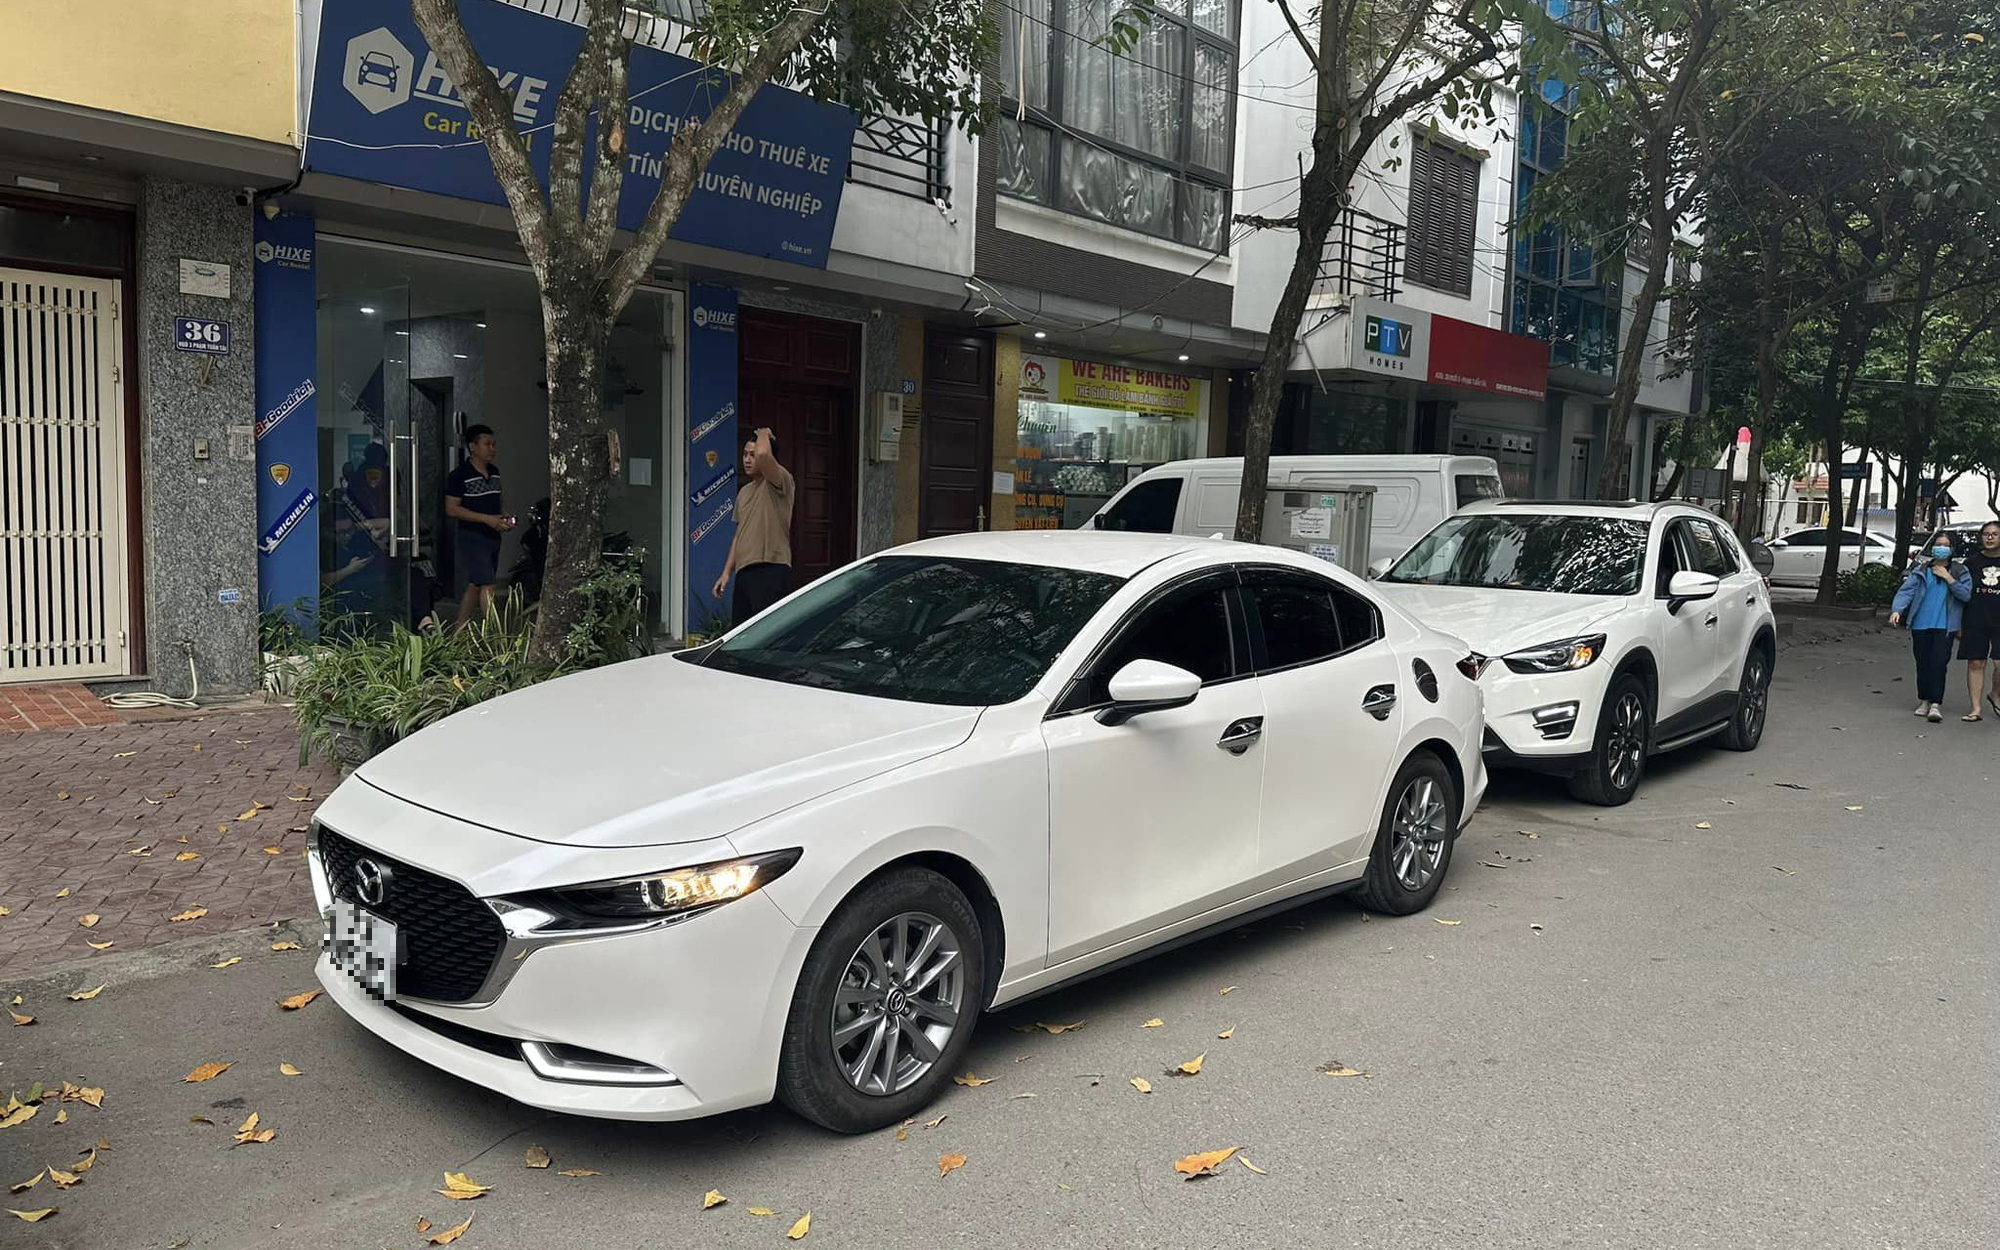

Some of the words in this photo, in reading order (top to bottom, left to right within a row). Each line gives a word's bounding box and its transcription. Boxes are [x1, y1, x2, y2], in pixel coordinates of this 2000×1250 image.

[416, 51, 548, 118] HE
[424, 112, 461, 135] Car
[629, 106, 679, 135] DỊCH
[720, 131, 754, 154] HO
[758, 140, 806, 168] THUÊ
[807, 154, 830, 175] XE
[628, 152, 662, 179] TÍN
[697, 172, 753, 200] HUYÊN
[757, 185, 822, 218] NGHIỆP
[275, 245, 312, 261] HIXE
[185, 321, 221, 342] 36
[707, 310, 735, 325] HIXE
[1367, 322, 1410, 350] PTV
[1072, 360, 1096, 379] WE
[1101, 363, 1131, 383] ARE
[1136, 370, 1191, 392] BAKERS
[1369, 356, 1404, 370] HOMES
[903, 381, 915, 393] 30
[255, 380, 313, 436] BFGoodrich
[704, 468, 735, 496] MICHELIN
[275, 492, 314, 538] MICHELIN
